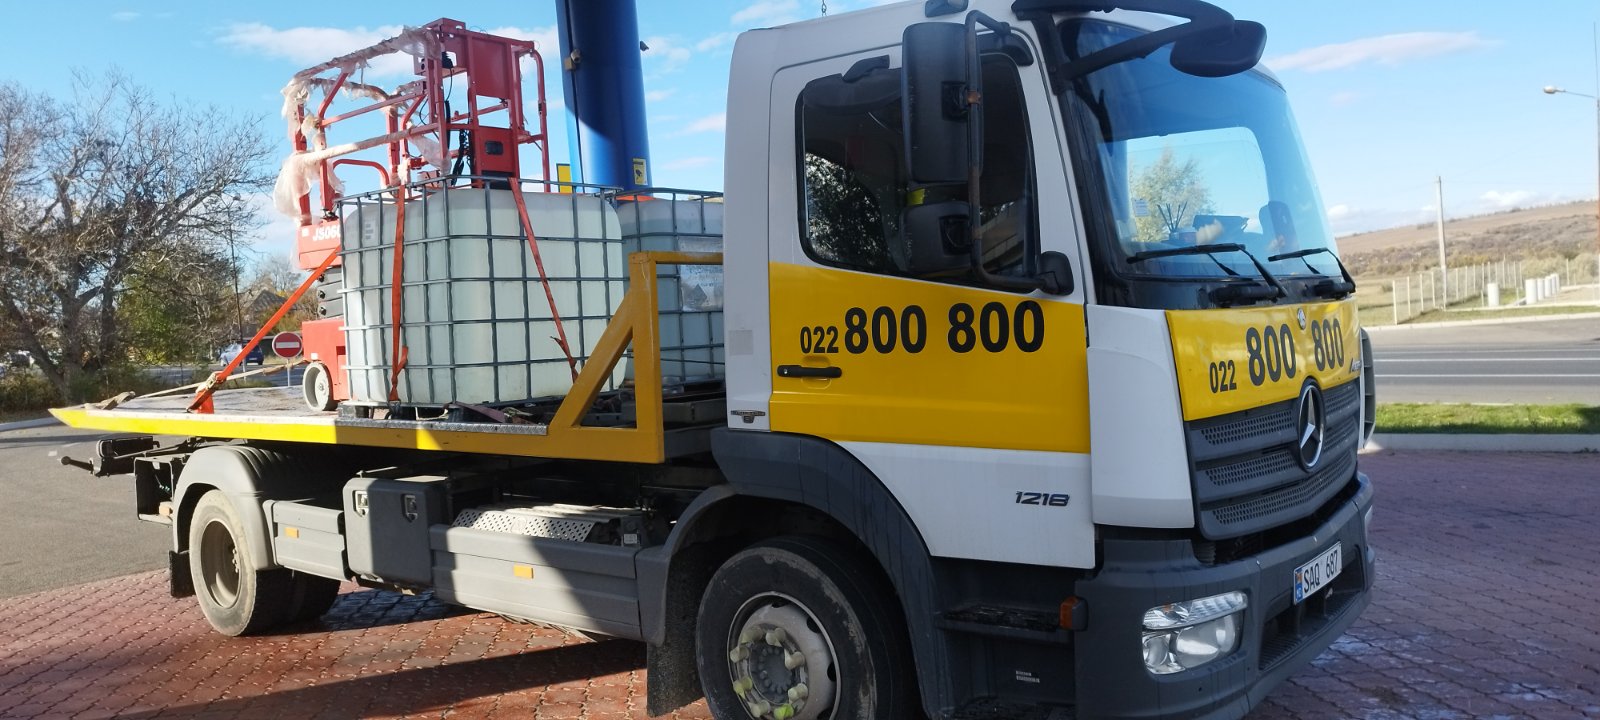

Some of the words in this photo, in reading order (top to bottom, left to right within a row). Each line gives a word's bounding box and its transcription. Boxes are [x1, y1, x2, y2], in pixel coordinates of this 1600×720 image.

[800, 326, 839, 354] 022
[844, 305, 927, 354] 800
[947, 300, 1045, 353] 800
[1209, 359, 1237, 394] 022
[1246, 323, 1297, 387] 800
[1311, 318, 1345, 372] 800
[1016, 491, 1070, 507] 1218
[1303, 562, 1320, 594] SAQ
[1325, 549, 1338, 579] 687
